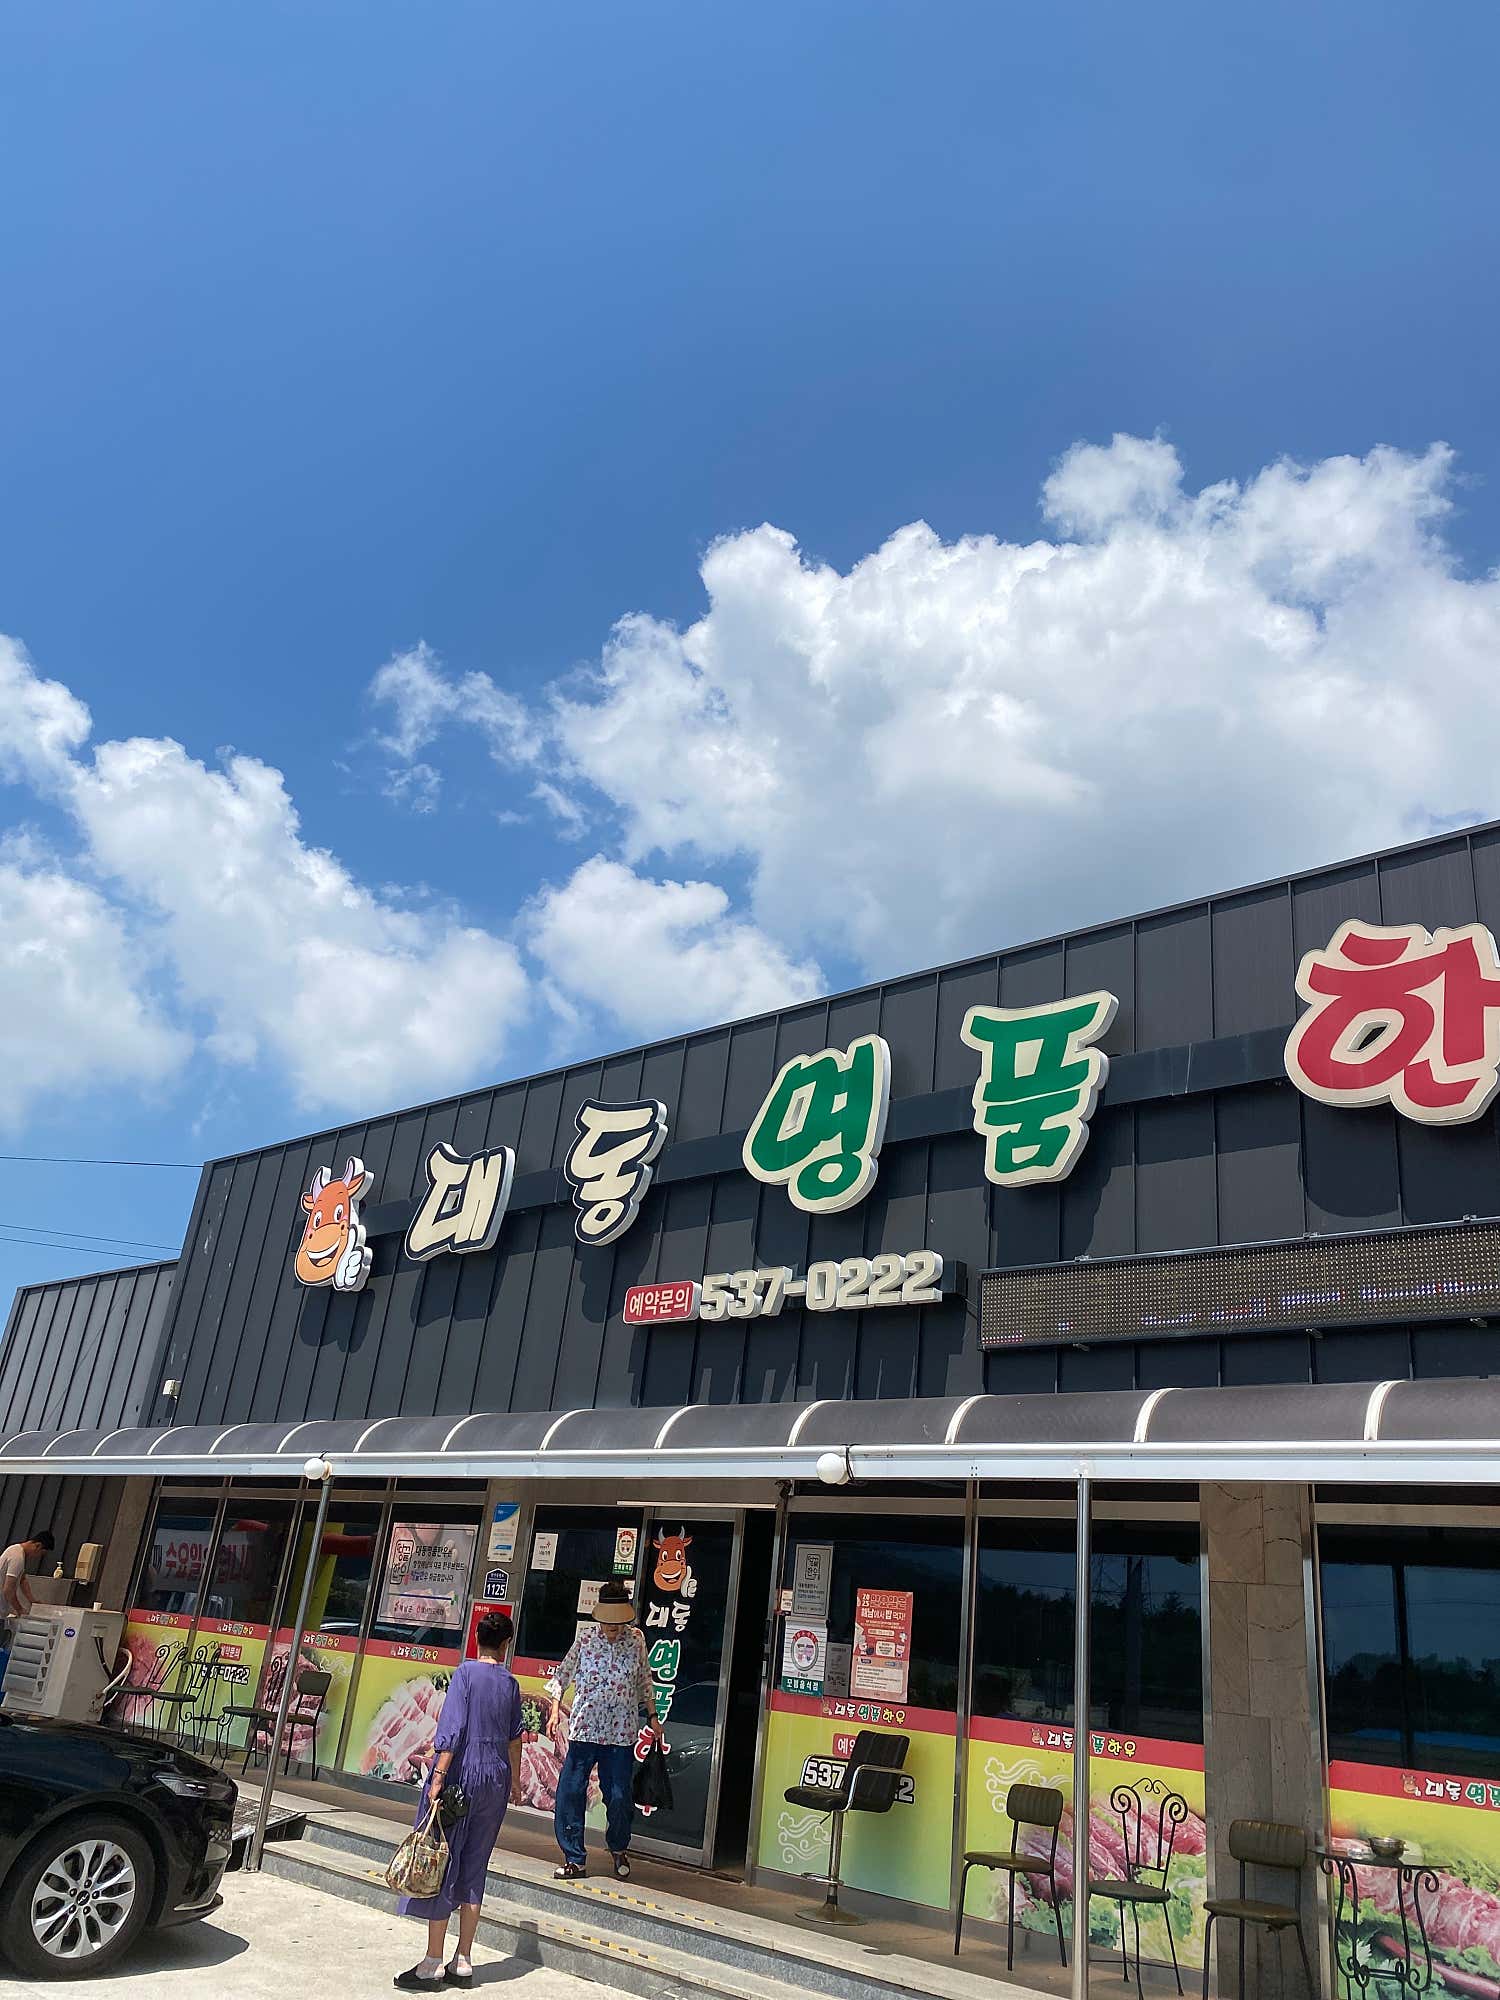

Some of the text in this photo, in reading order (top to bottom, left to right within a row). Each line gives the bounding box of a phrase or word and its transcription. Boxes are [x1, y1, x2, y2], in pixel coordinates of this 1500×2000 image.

[1284, 918, 1500, 1126] 한
[628, 1286, 692, 1317] 예약문의
[700, 1250, 943, 1322] 537-0222
[486, 1583, 505, 1596] 1125
[645, 1601, 691, 1632] 대동
[861, 1608, 885, 1619] 해남에서
[886, 1609, 892, 1620] 밥
[786, 1678, 819, 1692] 모범음식점
[834, 1702, 856, 1717] 대동
[882, 1708, 906, 1725] 한우
[1047, 1730, 1074, 1749] 대동
[1107, 1738, 1136, 1757] 한우
[1425, 1778, 1462, 1801] 대동
